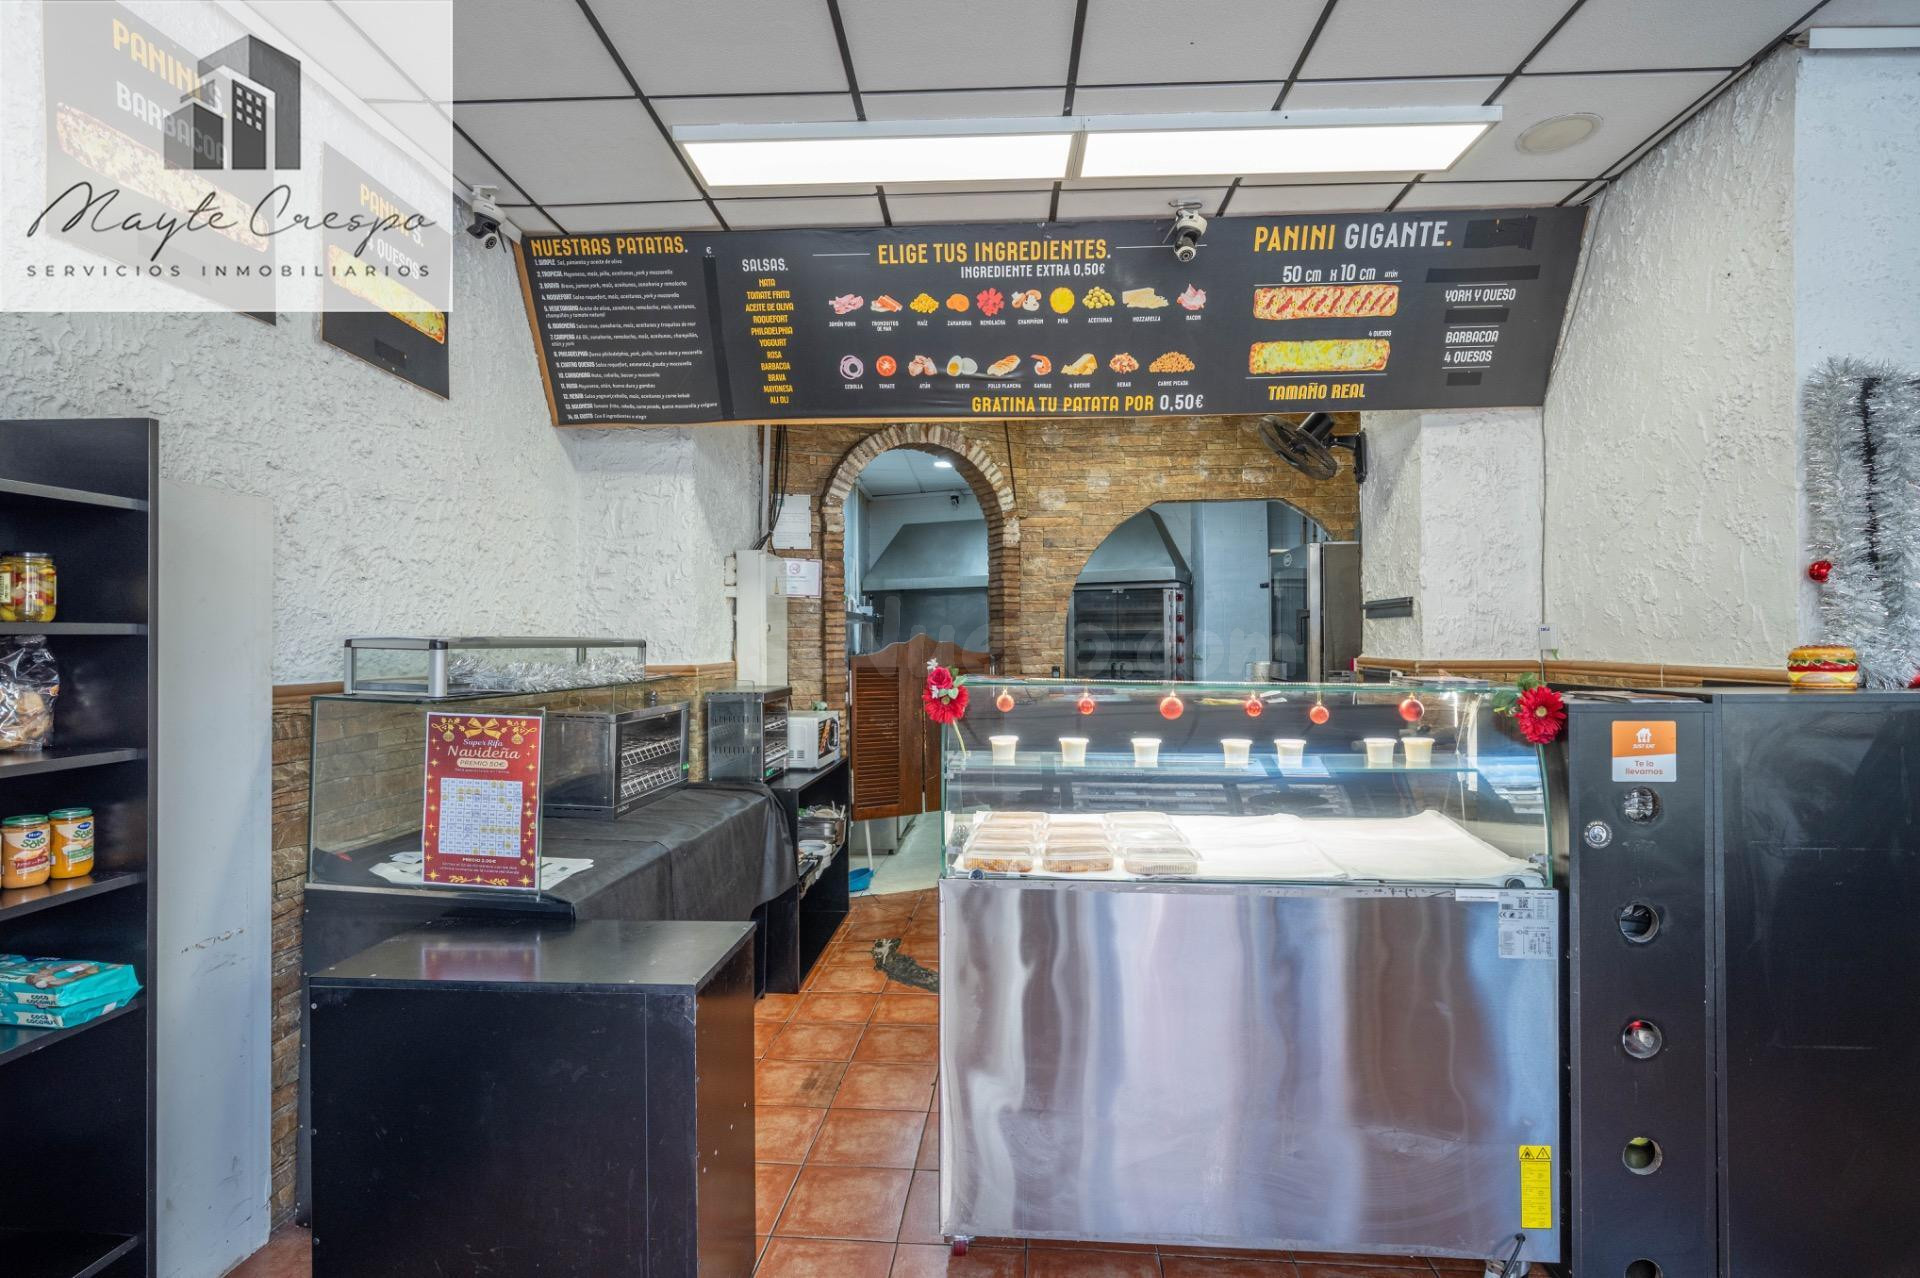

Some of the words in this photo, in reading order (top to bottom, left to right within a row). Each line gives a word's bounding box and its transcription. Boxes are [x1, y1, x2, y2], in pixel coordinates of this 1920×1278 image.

[1253, 224, 1336, 253] PANINI
[1344, 220, 1453, 249] GIGANTE.
[531, 238, 612, 257] NUESTRAS
[616, 236, 689, 255] PATATAS.
[878, 243, 928, 265] ELIGE
[933, 243, 968, 264] TUS
[975, 238, 1112, 263] INGREDIENTES.
[742, 258, 789, 272] SALSAS.
[960, 265, 1033, 279] INGREDIENTE
[1036, 264, 1071, 277] EXTRA
[1282, 265, 1302, 283] 50
[1340, 263, 1356, 281] 10
[758, 278, 776, 288] NATA
[746, 291, 771, 300] TOMATE
[772, 290, 791, 299] FRITO
[1445, 289, 1472, 302] YORK
[1474, 289, 1482, 301] Y
[1482, 288, 1517, 302] QUESO
[745, 303, 766, 312] ACEITE
[767, 303, 776, 312] DE
[776, 303, 794, 312] OLIVA
[752, 315, 788, 324] ROQUEFORT
[751, 326, 793, 336] PHILADELPHIA
[1445, 330, 1500, 344] BARBACOA
[766, 351, 782, 360] ROSA
[1444, 351, 1451, 363] 4
[1453, 350, 1493, 364] QUESOS
[760, 362, 791, 371] BARBACOA
[767, 373, 786, 382] BRAVA
[763, 384, 793, 394] MAYONESA
[1268, 382, 1328, 401] TAMAÑO
[1331, 383, 1366, 399] REAL
[971, 396, 1036, 413] GRATINA
[1038, 396, 1057, 412] TU
[1063, 396, 1120, 412] PATATA
[1125, 395, 1154, 411] POR
[487, 739, 503, 748] Rifa
[447, 745, 521, 759] Navideña
[459, 759, 489, 768] PREMIO
